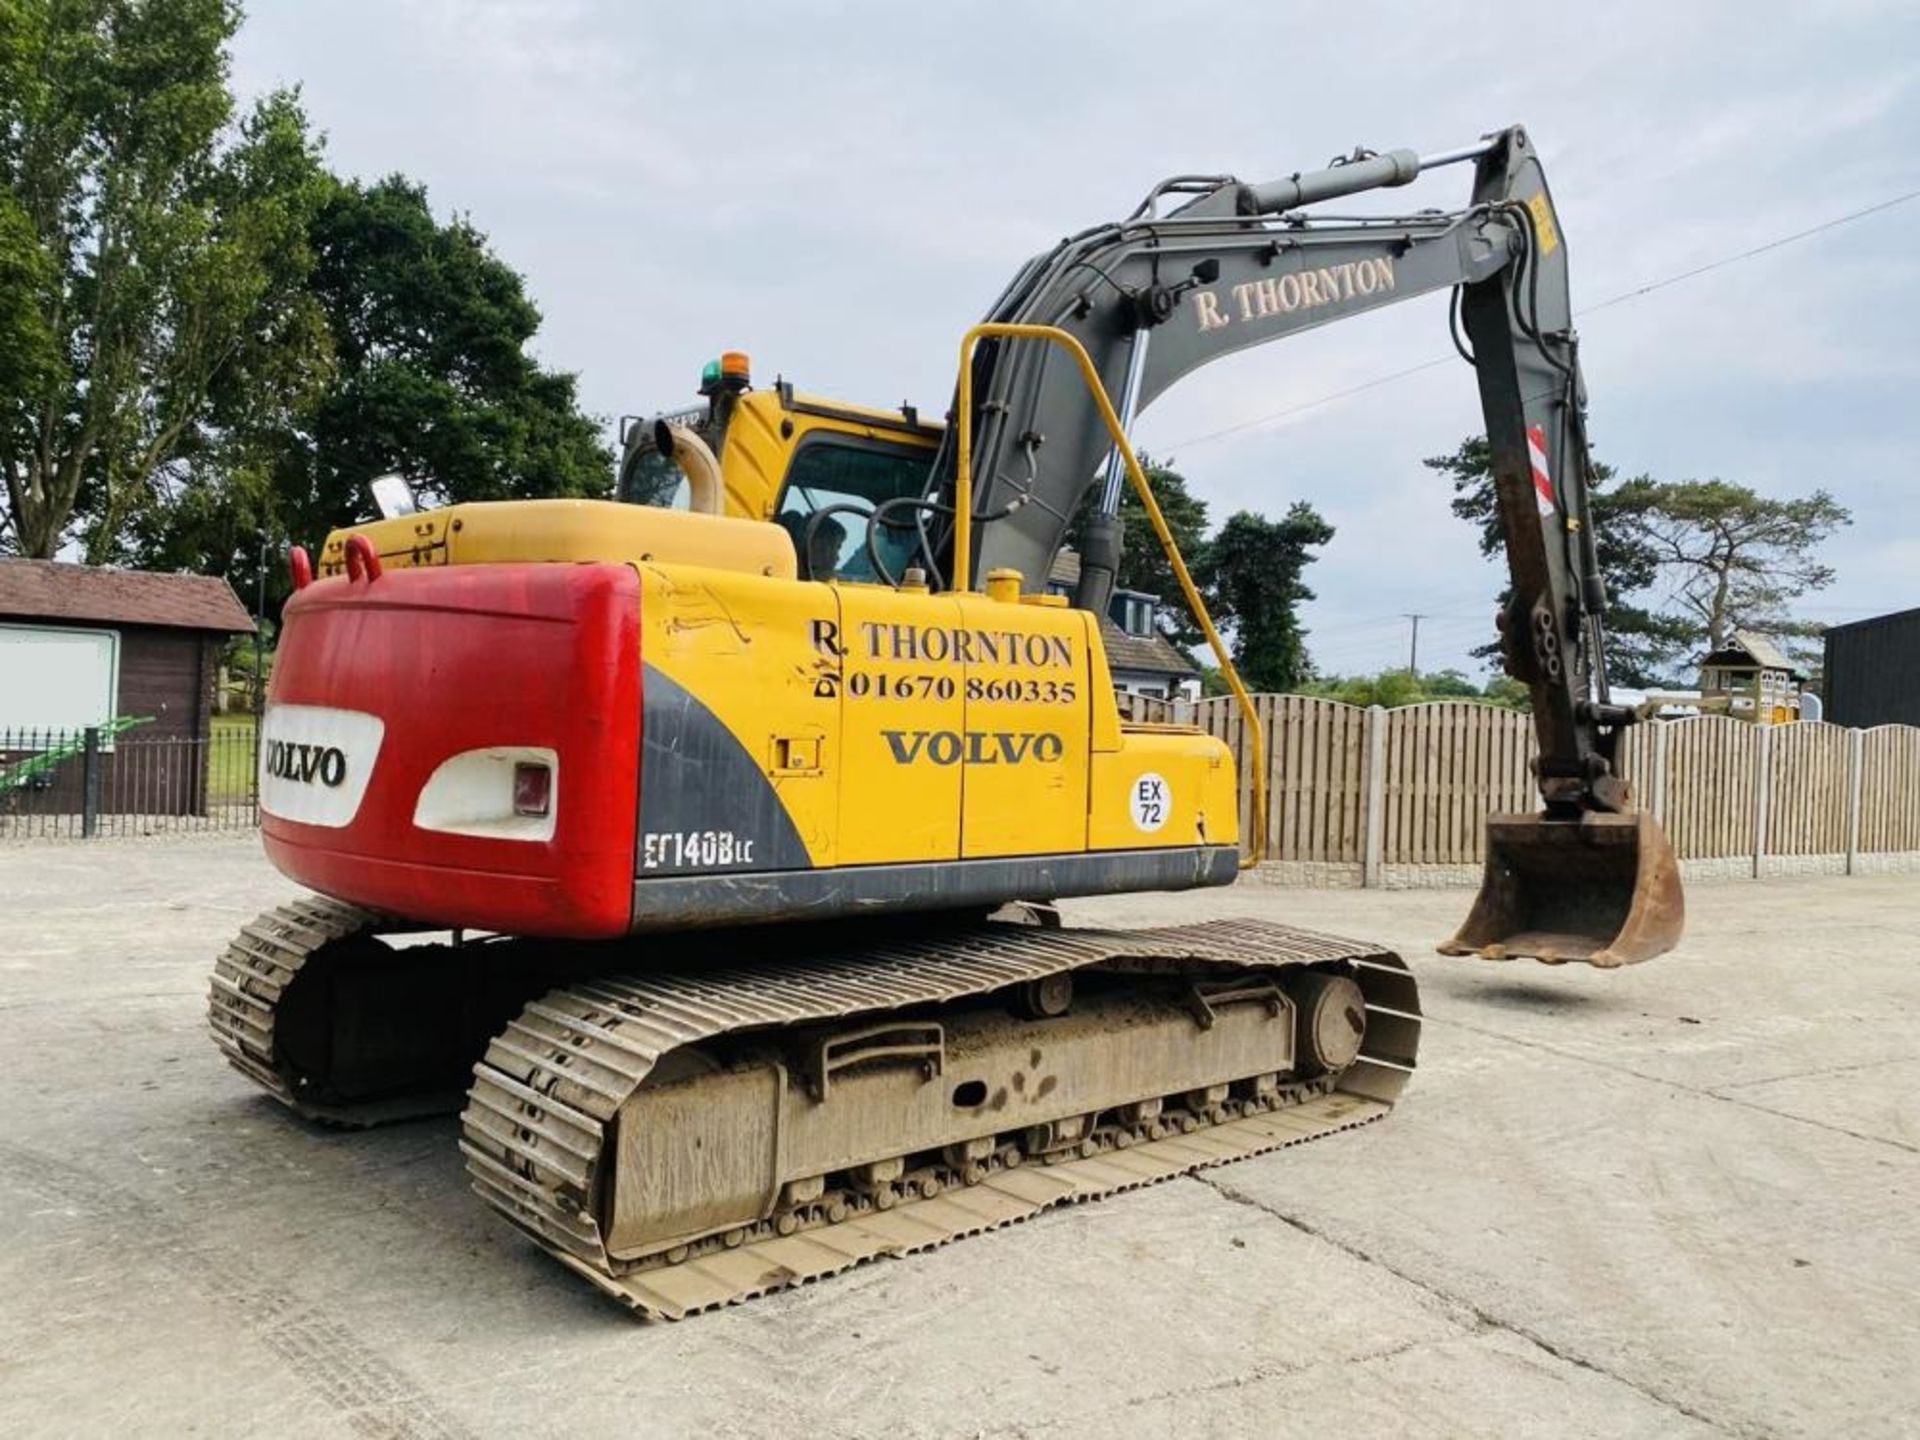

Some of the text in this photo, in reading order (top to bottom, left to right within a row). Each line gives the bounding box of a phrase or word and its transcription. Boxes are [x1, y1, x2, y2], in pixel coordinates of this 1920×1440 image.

[1193, 255, 1395, 332] R. THORNTON
[860, 621, 1073, 668] THORNTON
[849, 672, 1077, 704] 01670 860335
[266, 739, 346, 788] VOLVO
[880, 730, 1063, 766] VOLVO
[1139, 781, 1162, 800] EX
[1140, 803, 1161, 824] 72
